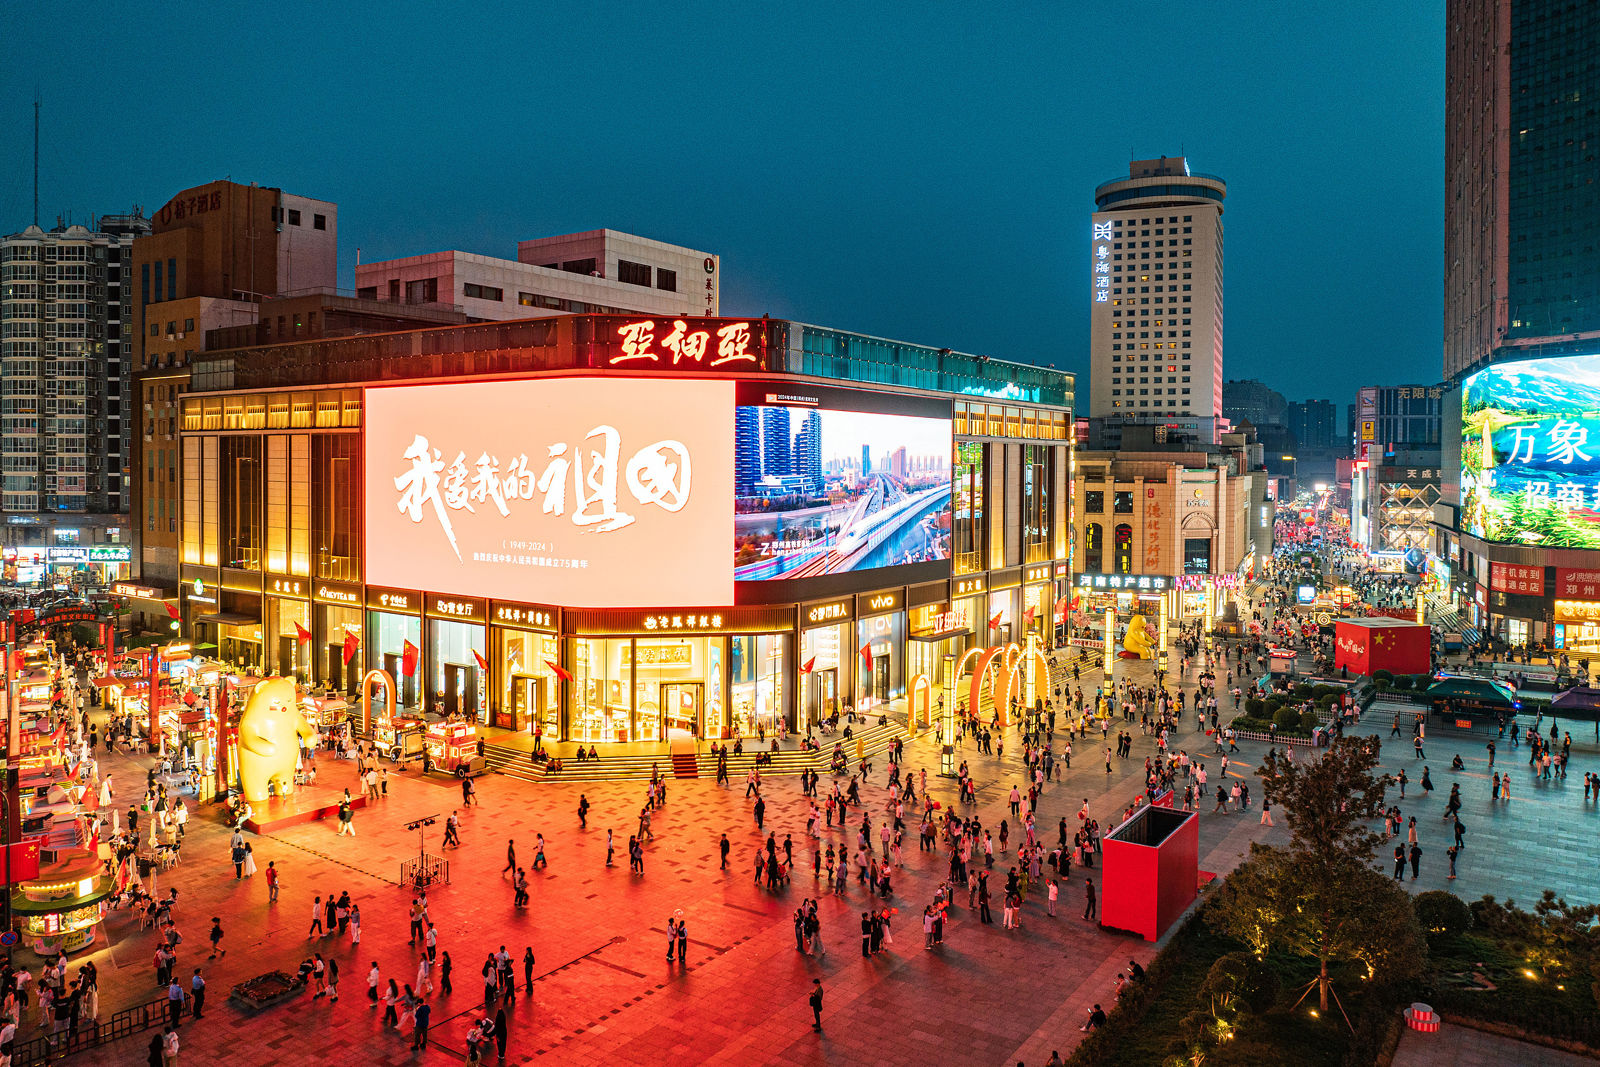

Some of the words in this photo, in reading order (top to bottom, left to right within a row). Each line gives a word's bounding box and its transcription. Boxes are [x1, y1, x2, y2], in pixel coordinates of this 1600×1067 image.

[1095, 245, 1110, 302] 粤海酒店
[1398, 387, 1443, 399] 无限城
[1507, 419, 1593, 464] 万象
[1492, 565, 1540, 580] 买手机就到
[1080, 575, 1166, 589] 河南特产超市
[871, 595, 894, 609] vivo
